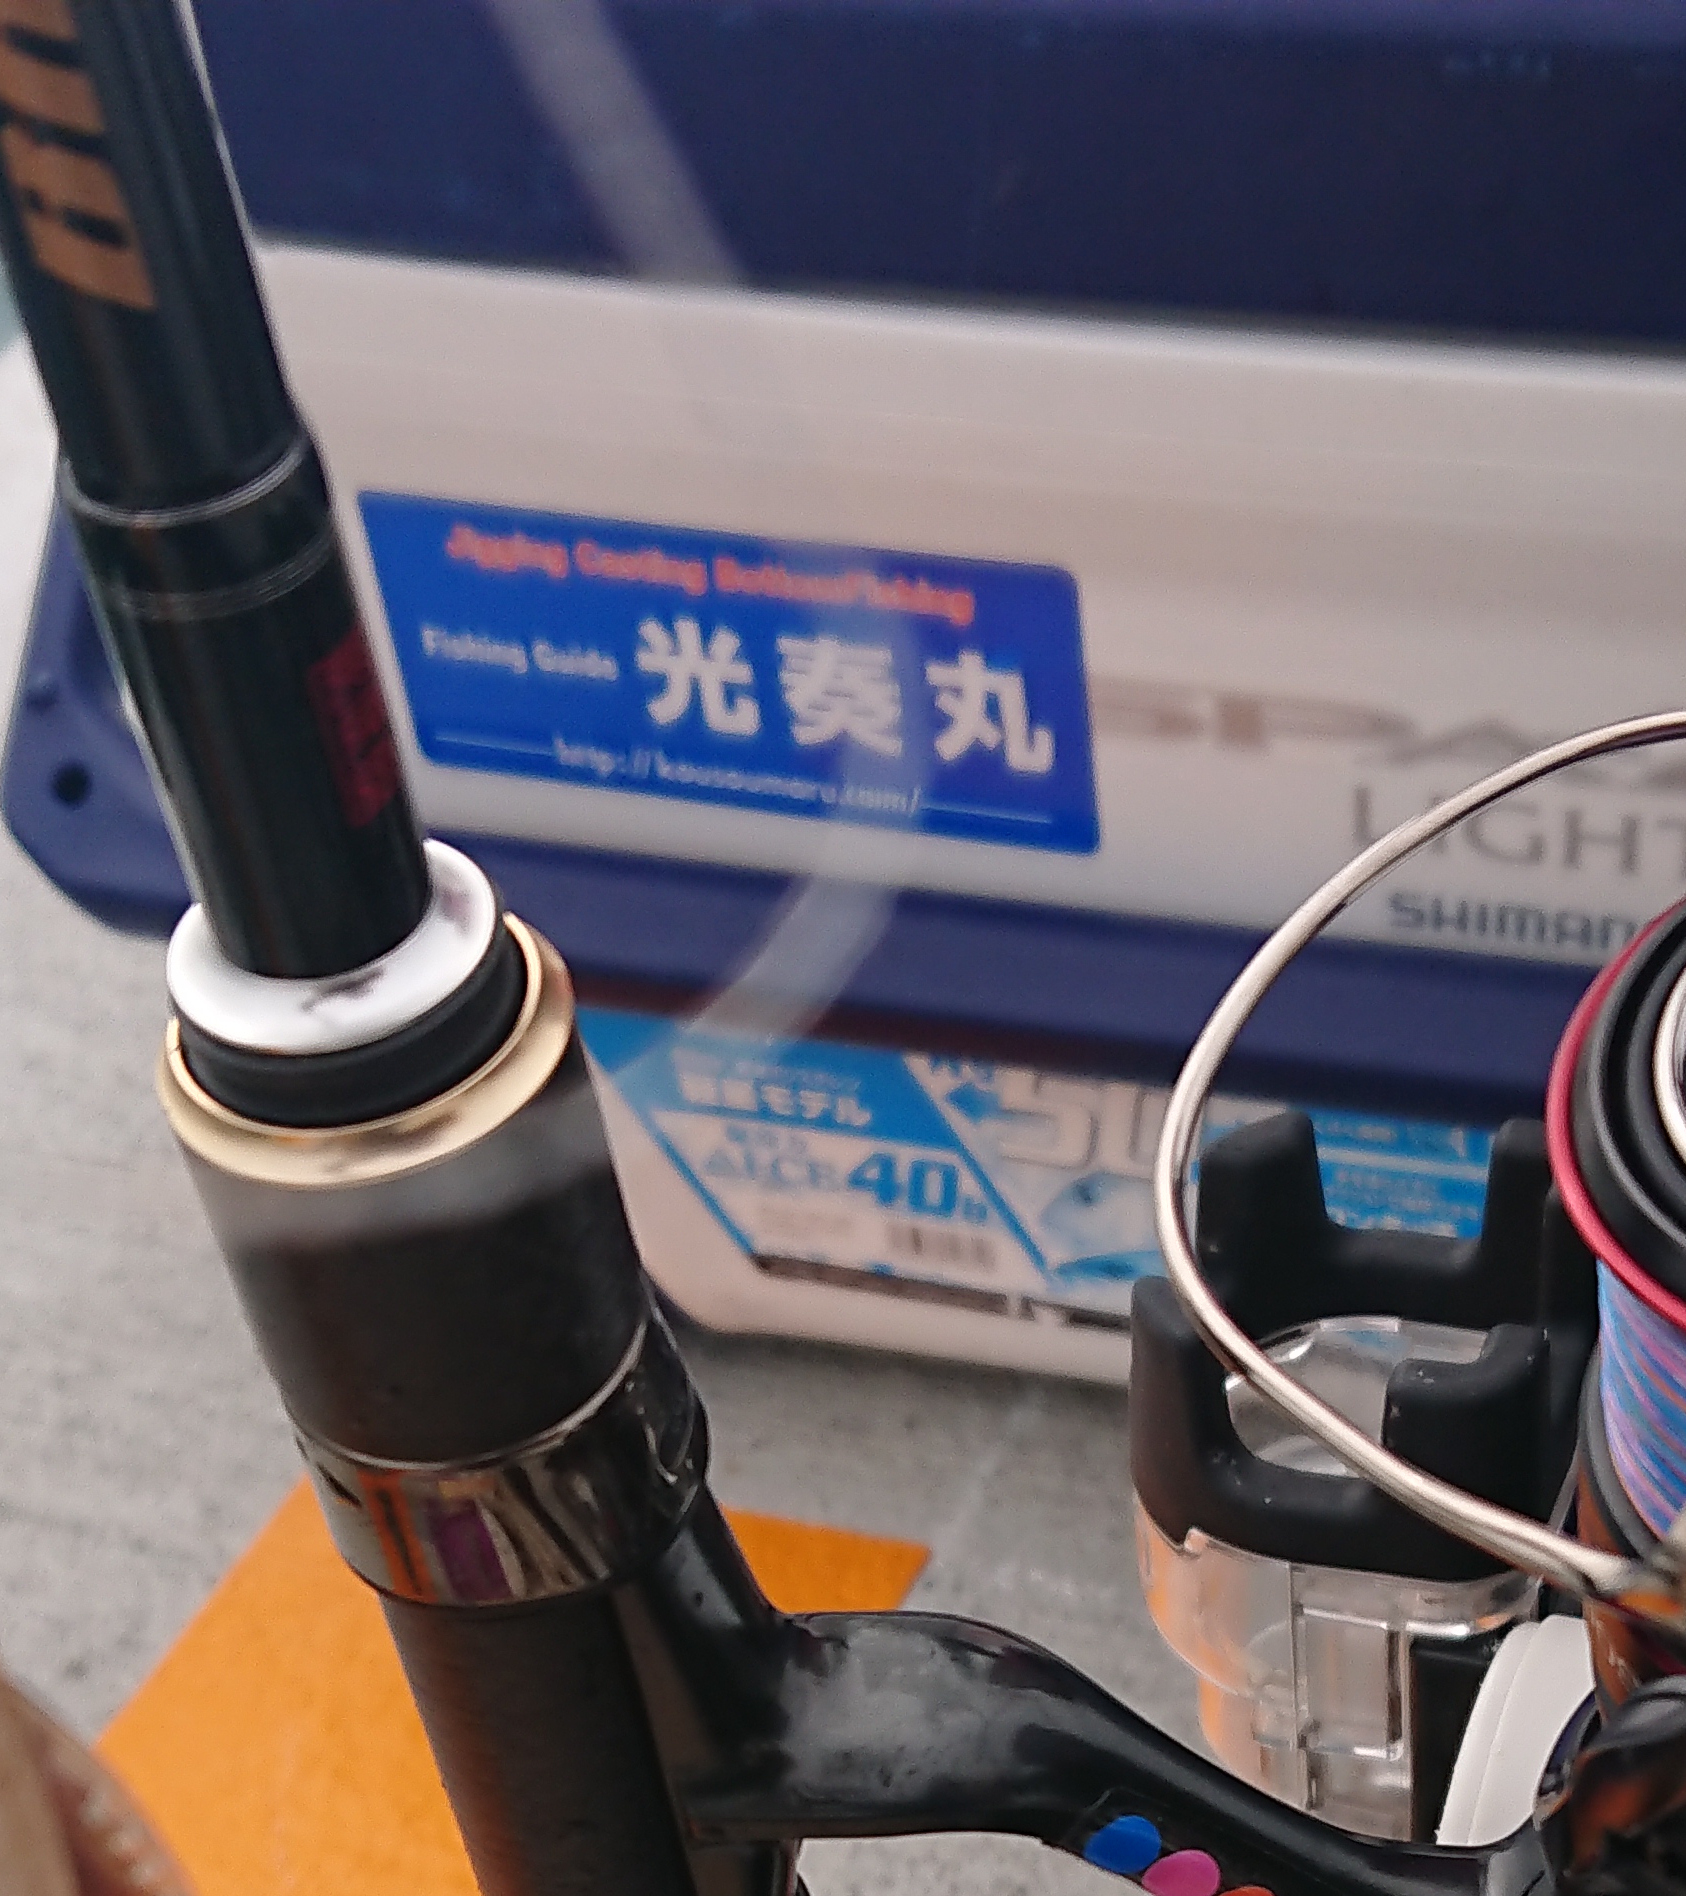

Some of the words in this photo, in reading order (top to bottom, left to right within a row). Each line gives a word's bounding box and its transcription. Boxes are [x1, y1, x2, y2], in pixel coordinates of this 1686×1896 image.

[421, 627, 527, 675] Fishing
[532, 638, 620, 682] Guide
[635, 616, 1054, 776] 光奏丸
[1388, 892, 1641, 951] SHIMAN
